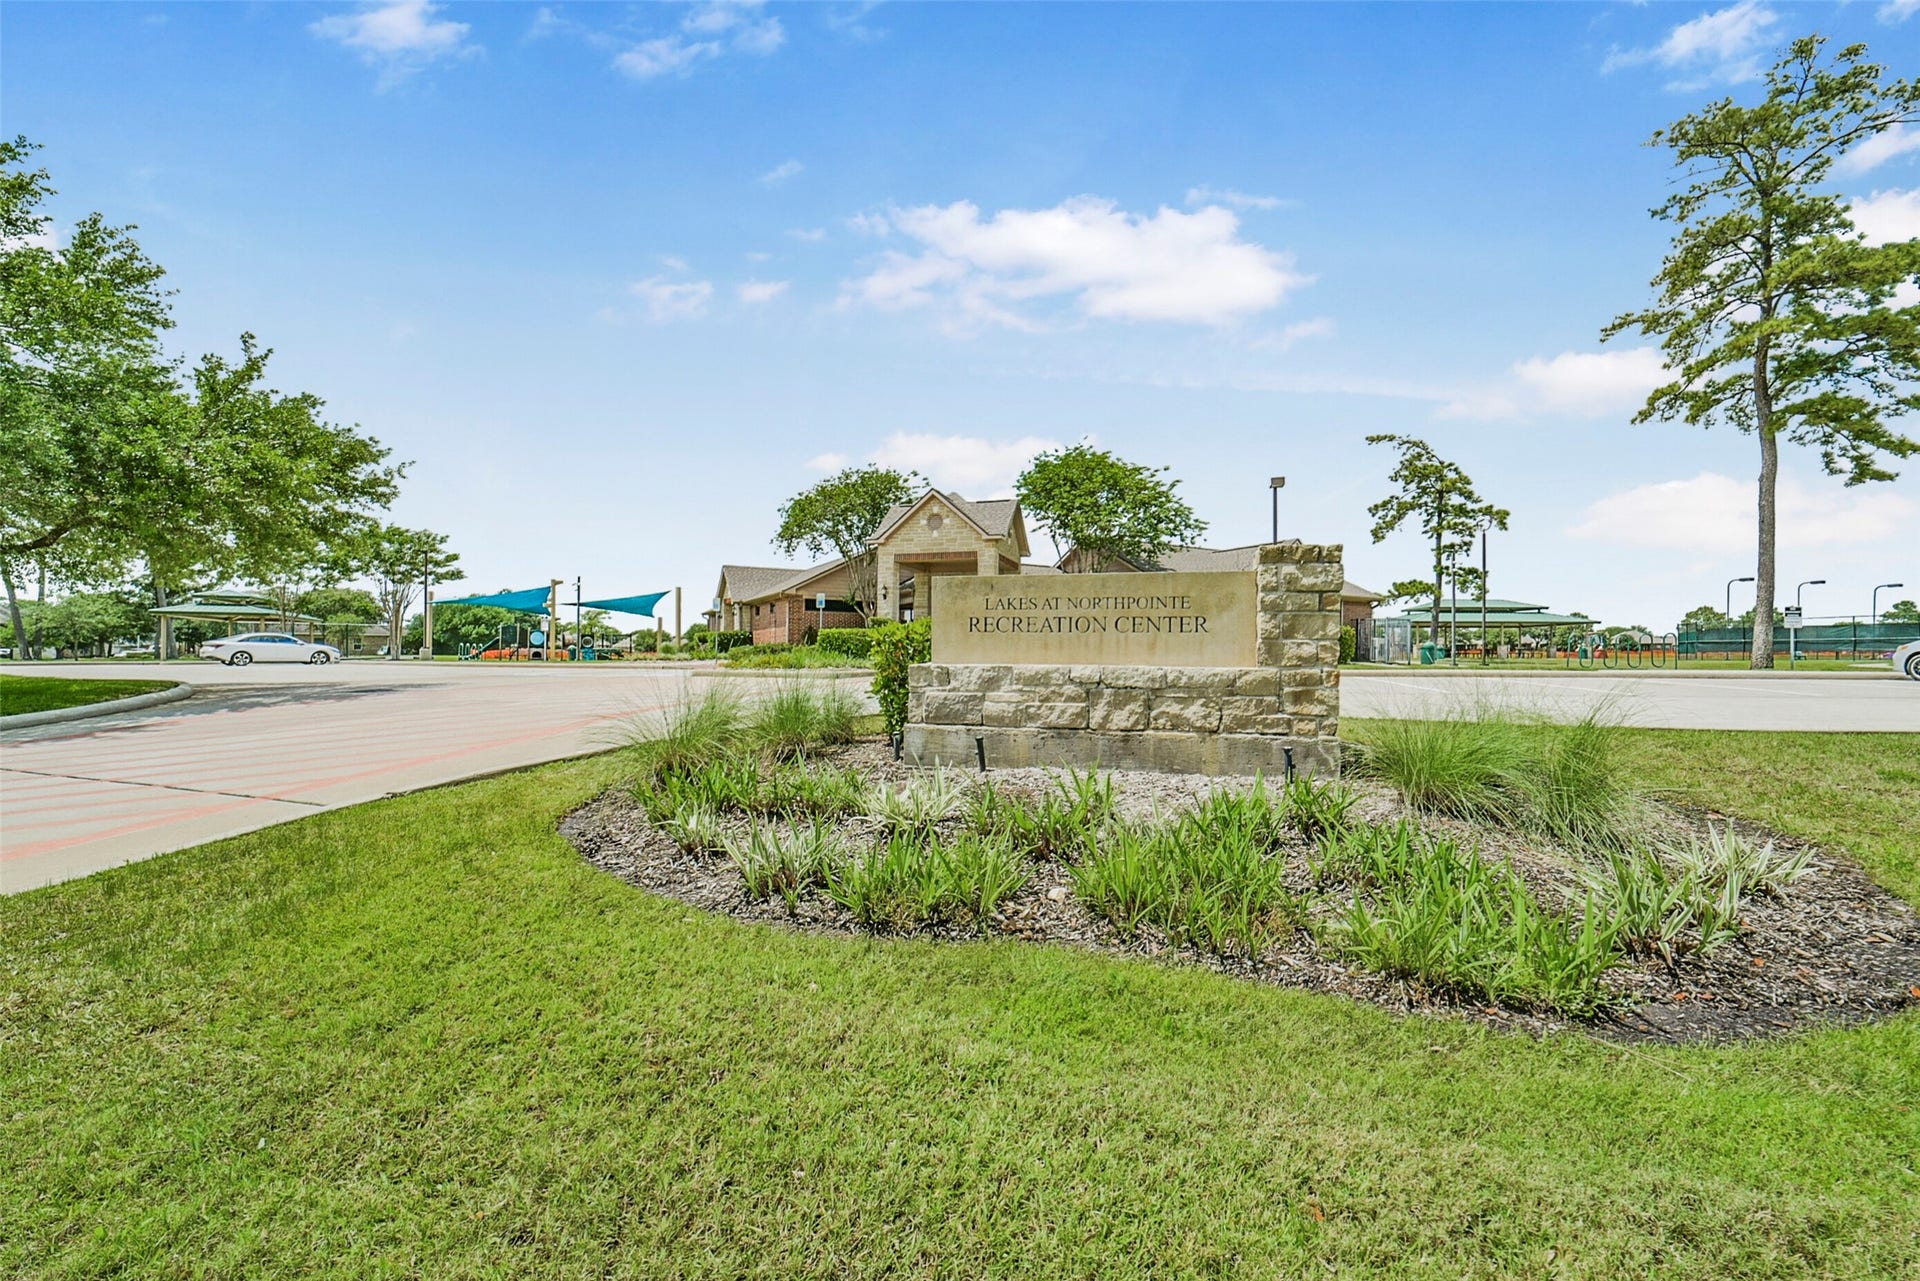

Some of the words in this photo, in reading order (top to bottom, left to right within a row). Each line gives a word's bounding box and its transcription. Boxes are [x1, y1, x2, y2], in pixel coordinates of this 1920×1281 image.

[984, 596, 1038, 611] LAKES
[1042, 596, 1061, 611] AT
[1067, 596, 1192, 610] NORTHPOINTE
[968, 616, 1107, 634] RECREATION
[1114, 616, 1209, 634] CENTER
